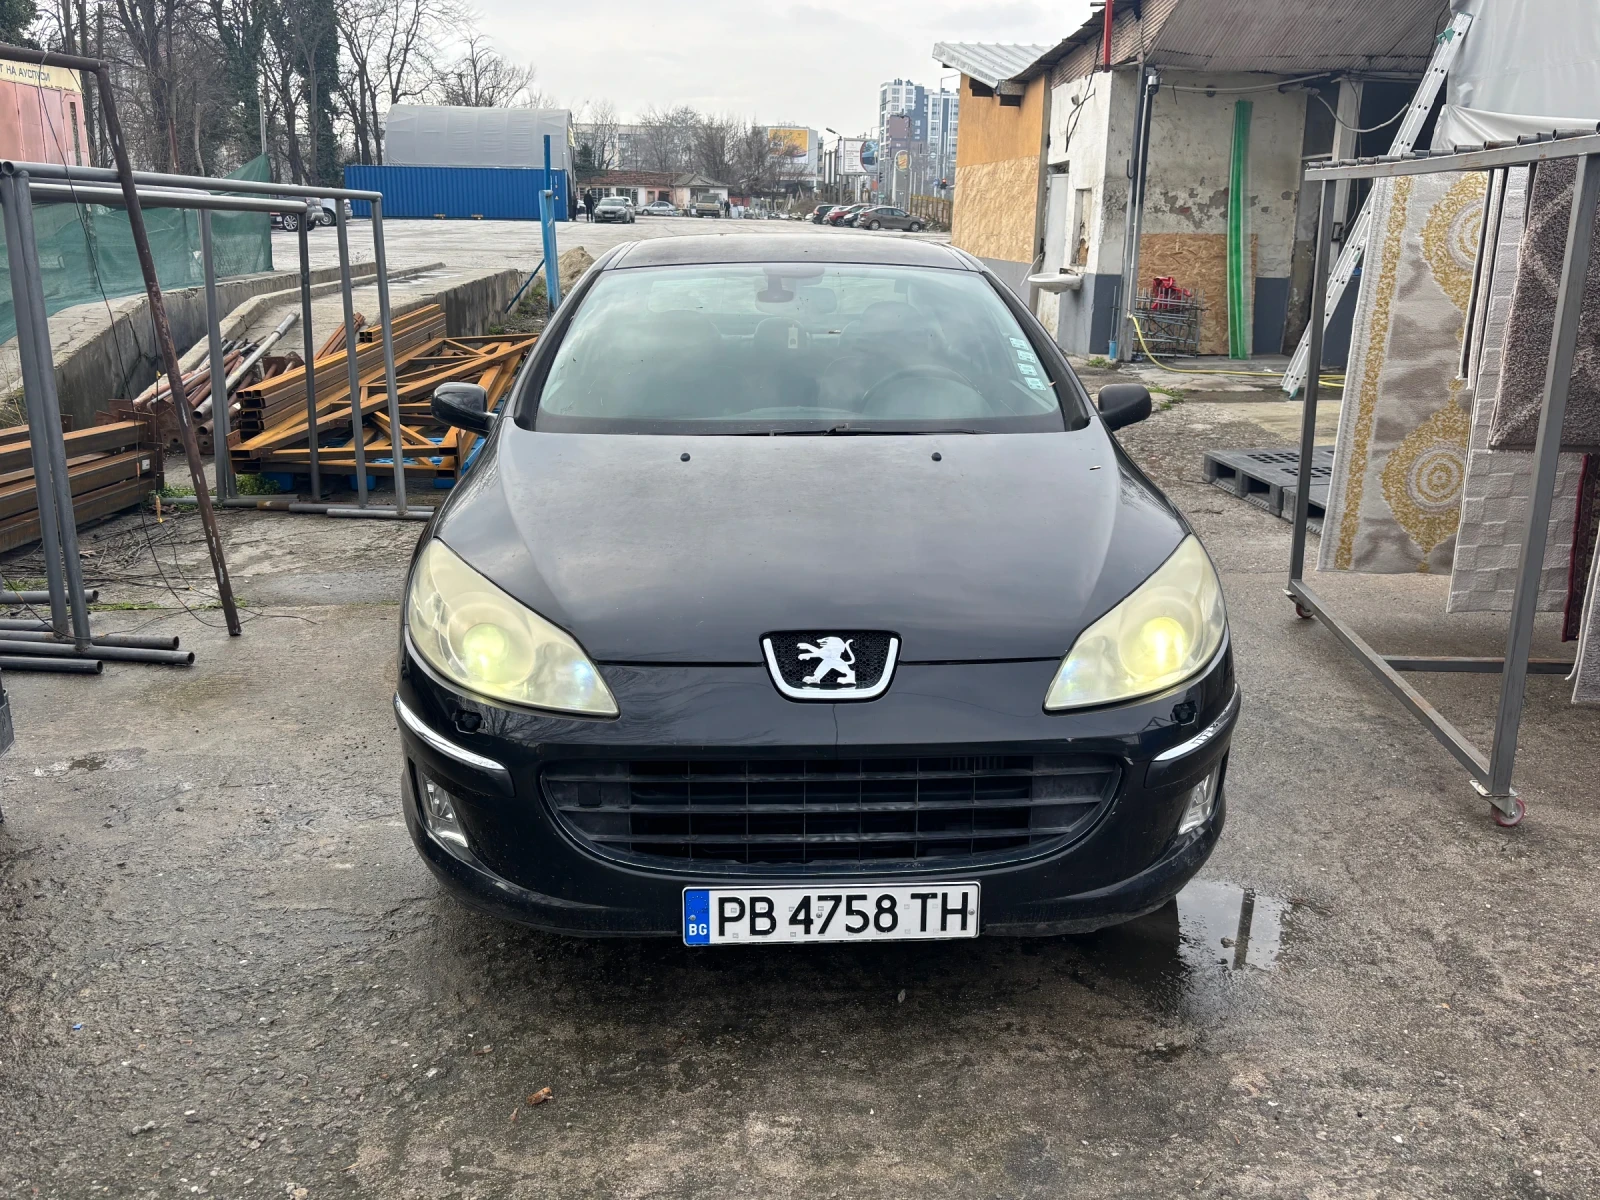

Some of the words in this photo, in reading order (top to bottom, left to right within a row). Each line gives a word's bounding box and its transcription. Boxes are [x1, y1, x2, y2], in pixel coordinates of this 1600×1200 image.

[6, 64, 17, 76] НА
[718, 896, 777, 937] PB
[788, 893, 899, 935] 4758
[910, 891, 969, 932] TH
[688, 923, 708, 936] BG
